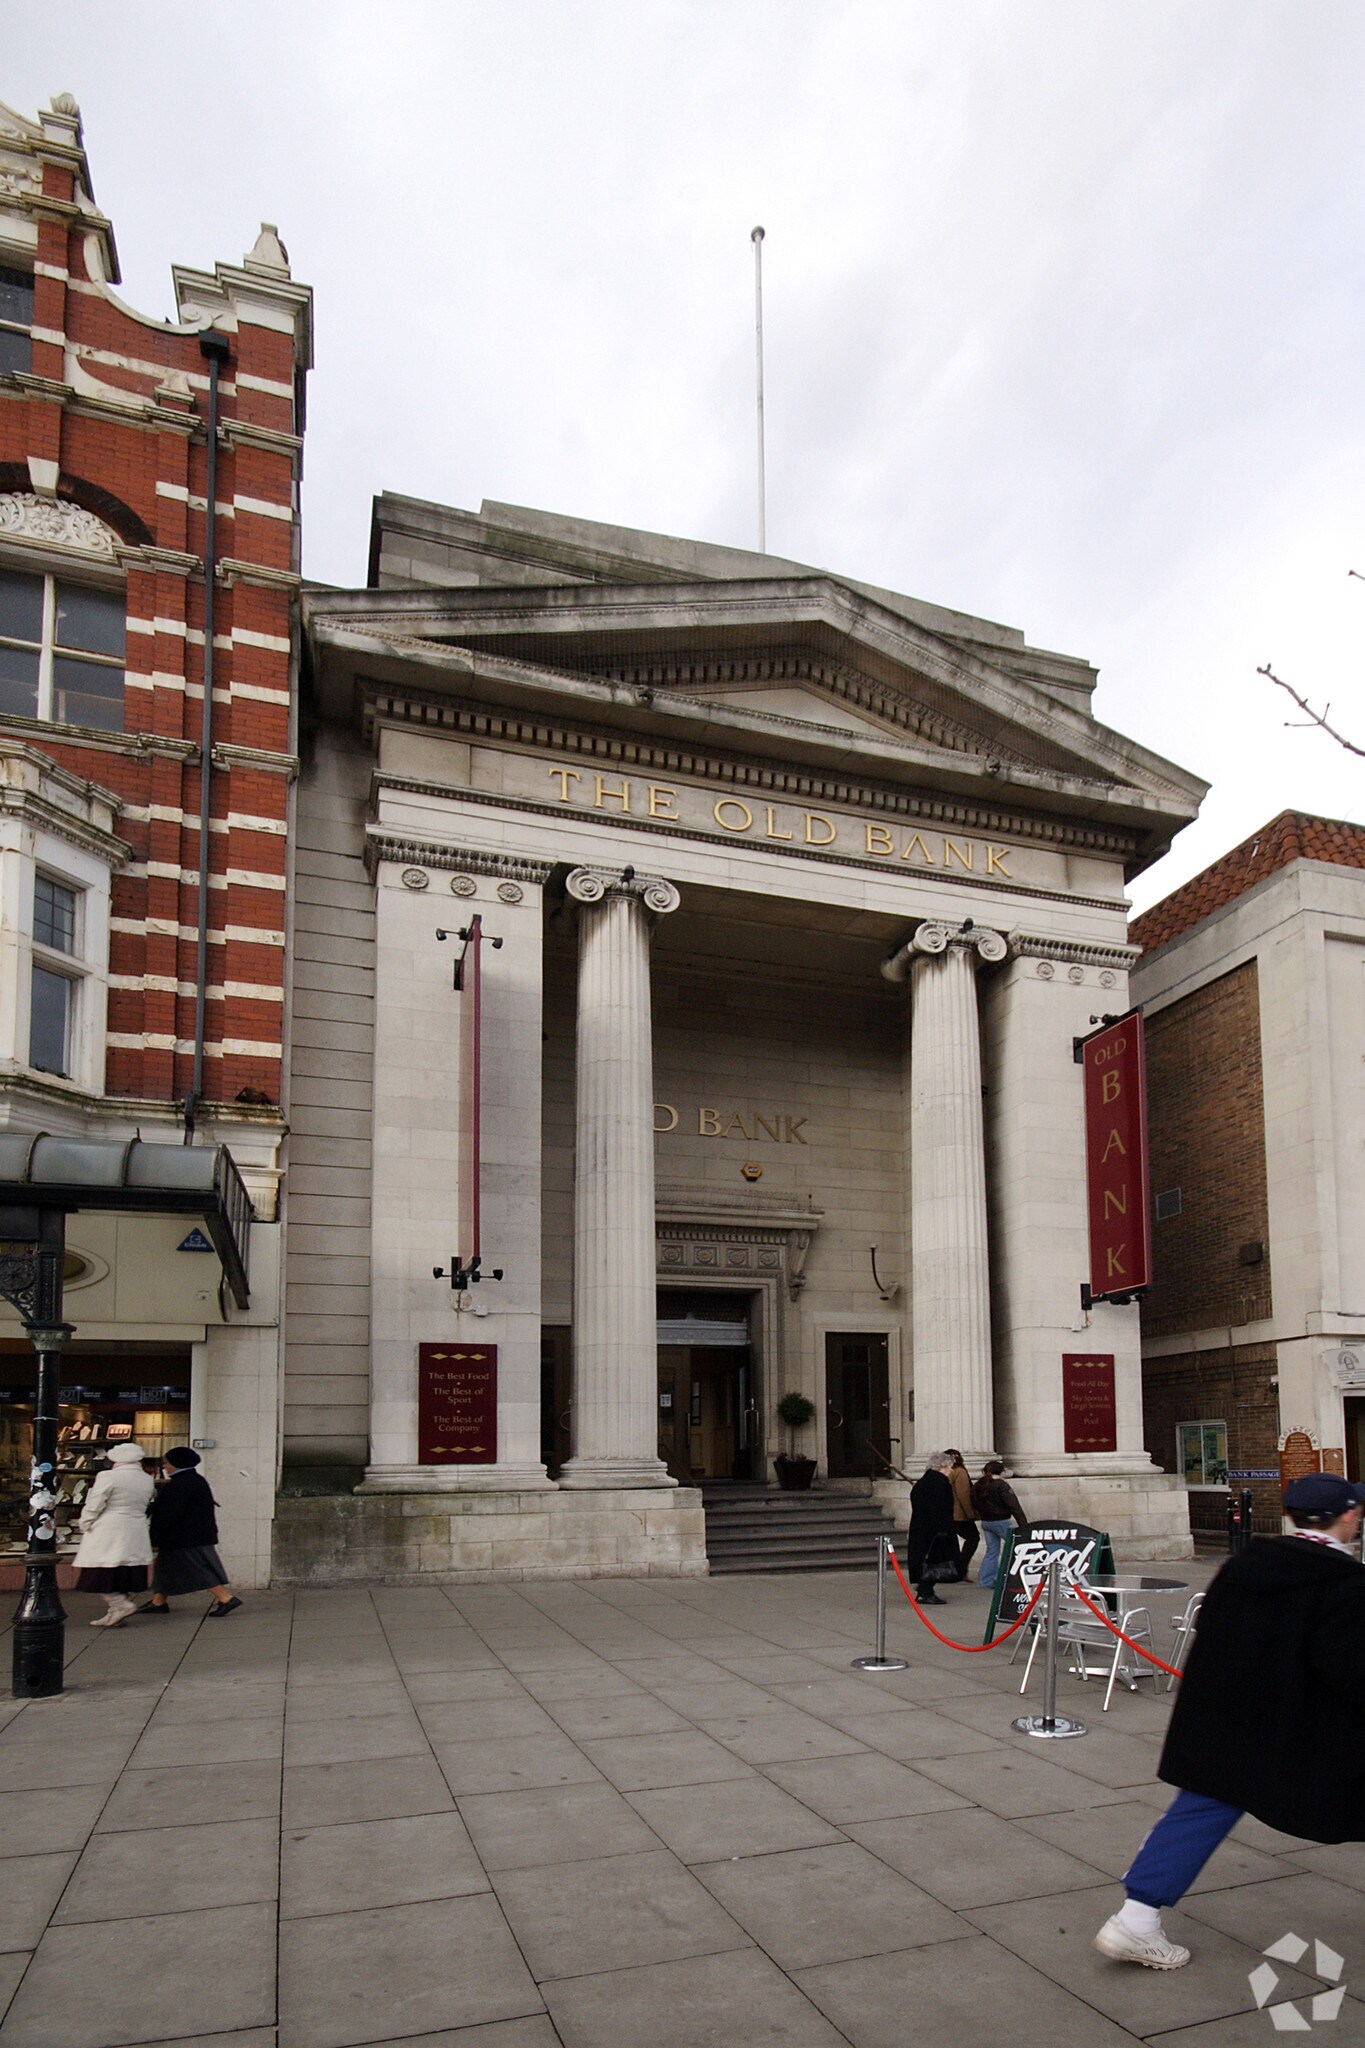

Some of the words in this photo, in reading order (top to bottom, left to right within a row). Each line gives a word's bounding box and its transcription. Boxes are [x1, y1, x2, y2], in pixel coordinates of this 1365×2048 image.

[548, 767, 680, 822] THE
[713, 799, 837, 846] OLD
[864, 823, 1013, 878] BANK
[1094, 1037, 1127, 1066] OLD
[698, 1107, 809, 1145] BANK
[1100, 1069, 1128, 1278] BANK
[468, 1372, 490, 1380] Food
[448, 1396, 472, 1406] Sport
[434, 1416, 450, 1424] The
[438, 1424, 480, 1434] Company
[1032, 1530, 1078, 1540] NEW!
[1009, 1540, 1096, 1576] Food
